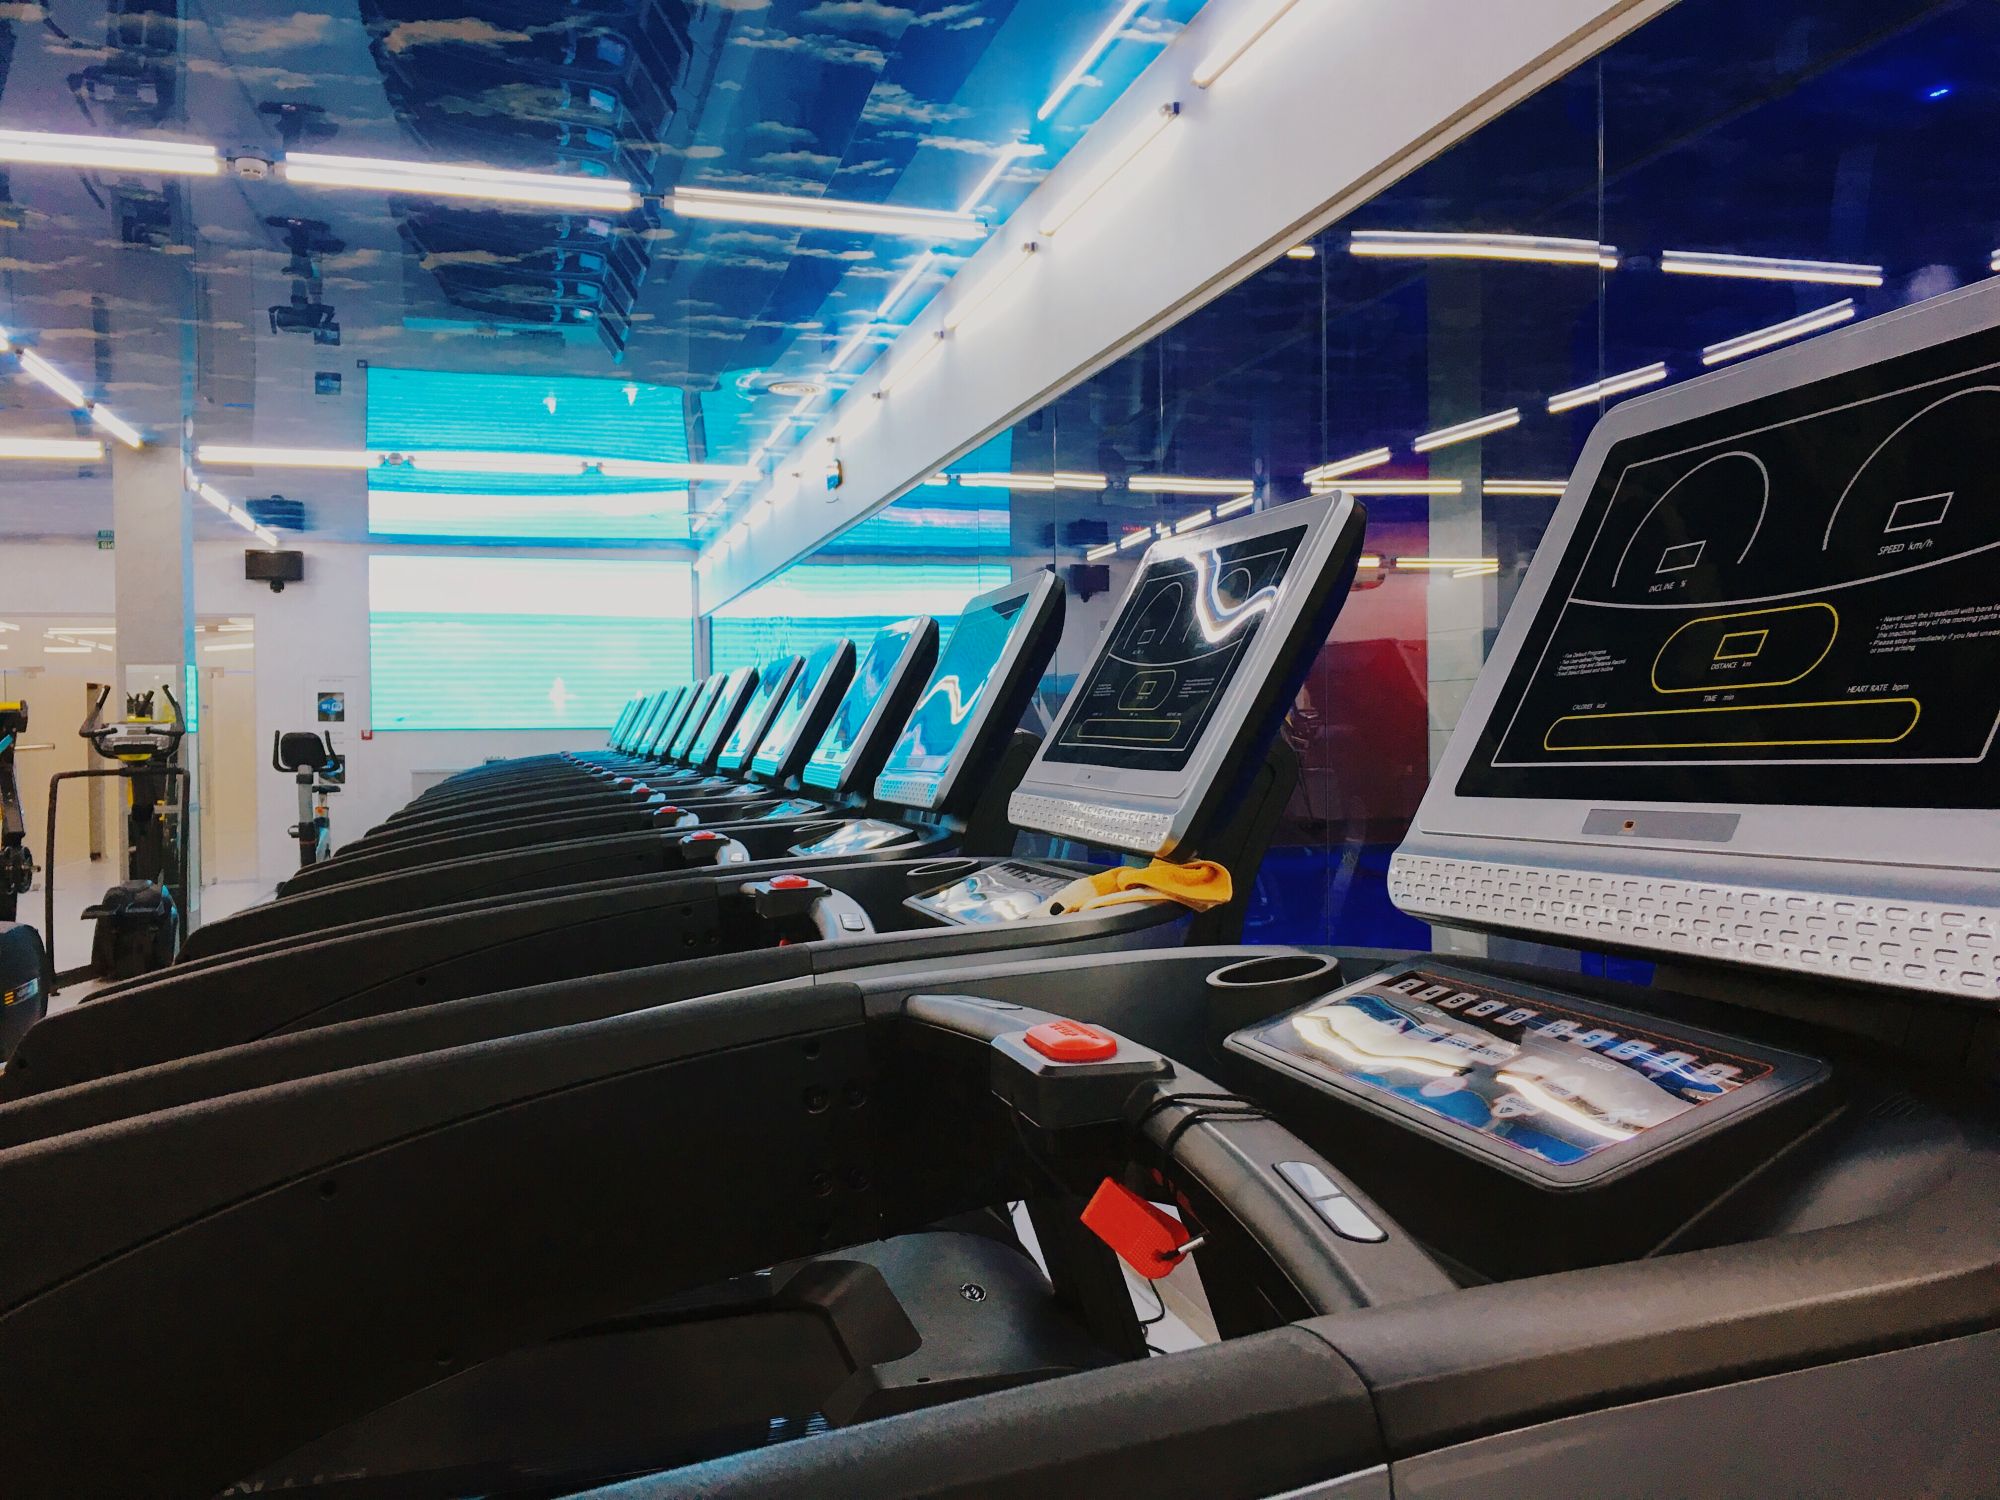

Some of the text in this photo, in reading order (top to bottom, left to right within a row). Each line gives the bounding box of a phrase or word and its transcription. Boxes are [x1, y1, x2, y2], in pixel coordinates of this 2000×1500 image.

[1877, 538, 1933, 556] SPEED km/h
[1917, 612, 1929, 620] the
[1929, 608, 1961, 618] treadmill
[1960, 606, 1975, 614] with
[1880, 622, 1899, 631] Don't
[1918, 620, 1931, 628] any
[1951, 616, 1979, 624] moving
[1710, 661, 1738, 670] DISTANCE
[1846, 682, 1910, 694] HEART RATE bpm
[1703, 694, 1718, 702] TIME
[1506, 1011, 1527, 1021] 10
[1546, 1023, 1569, 1034] 10
[1576, 1055, 1619, 1072] SPEED
